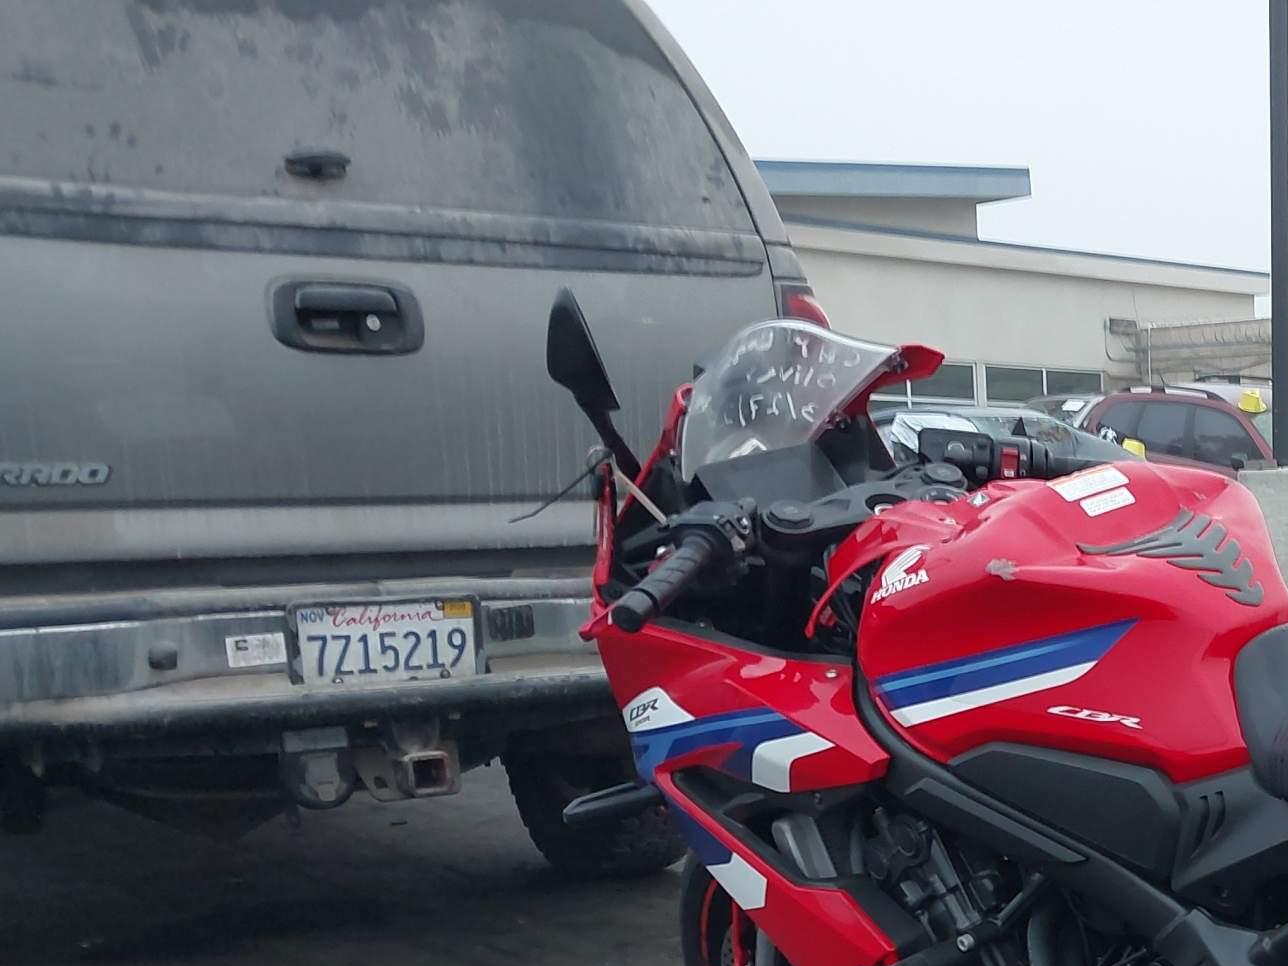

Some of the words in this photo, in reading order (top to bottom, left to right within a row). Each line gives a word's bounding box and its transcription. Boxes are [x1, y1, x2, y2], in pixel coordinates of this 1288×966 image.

[870, 569, 929, 605] HONDA
[300, 610, 325, 622] NOV
[331, 603, 445, 631] California
[306, 628, 467, 678] 7Z15219
[630, 698, 659, 722] CBR
[1047, 705, 1143, 729] CBR
